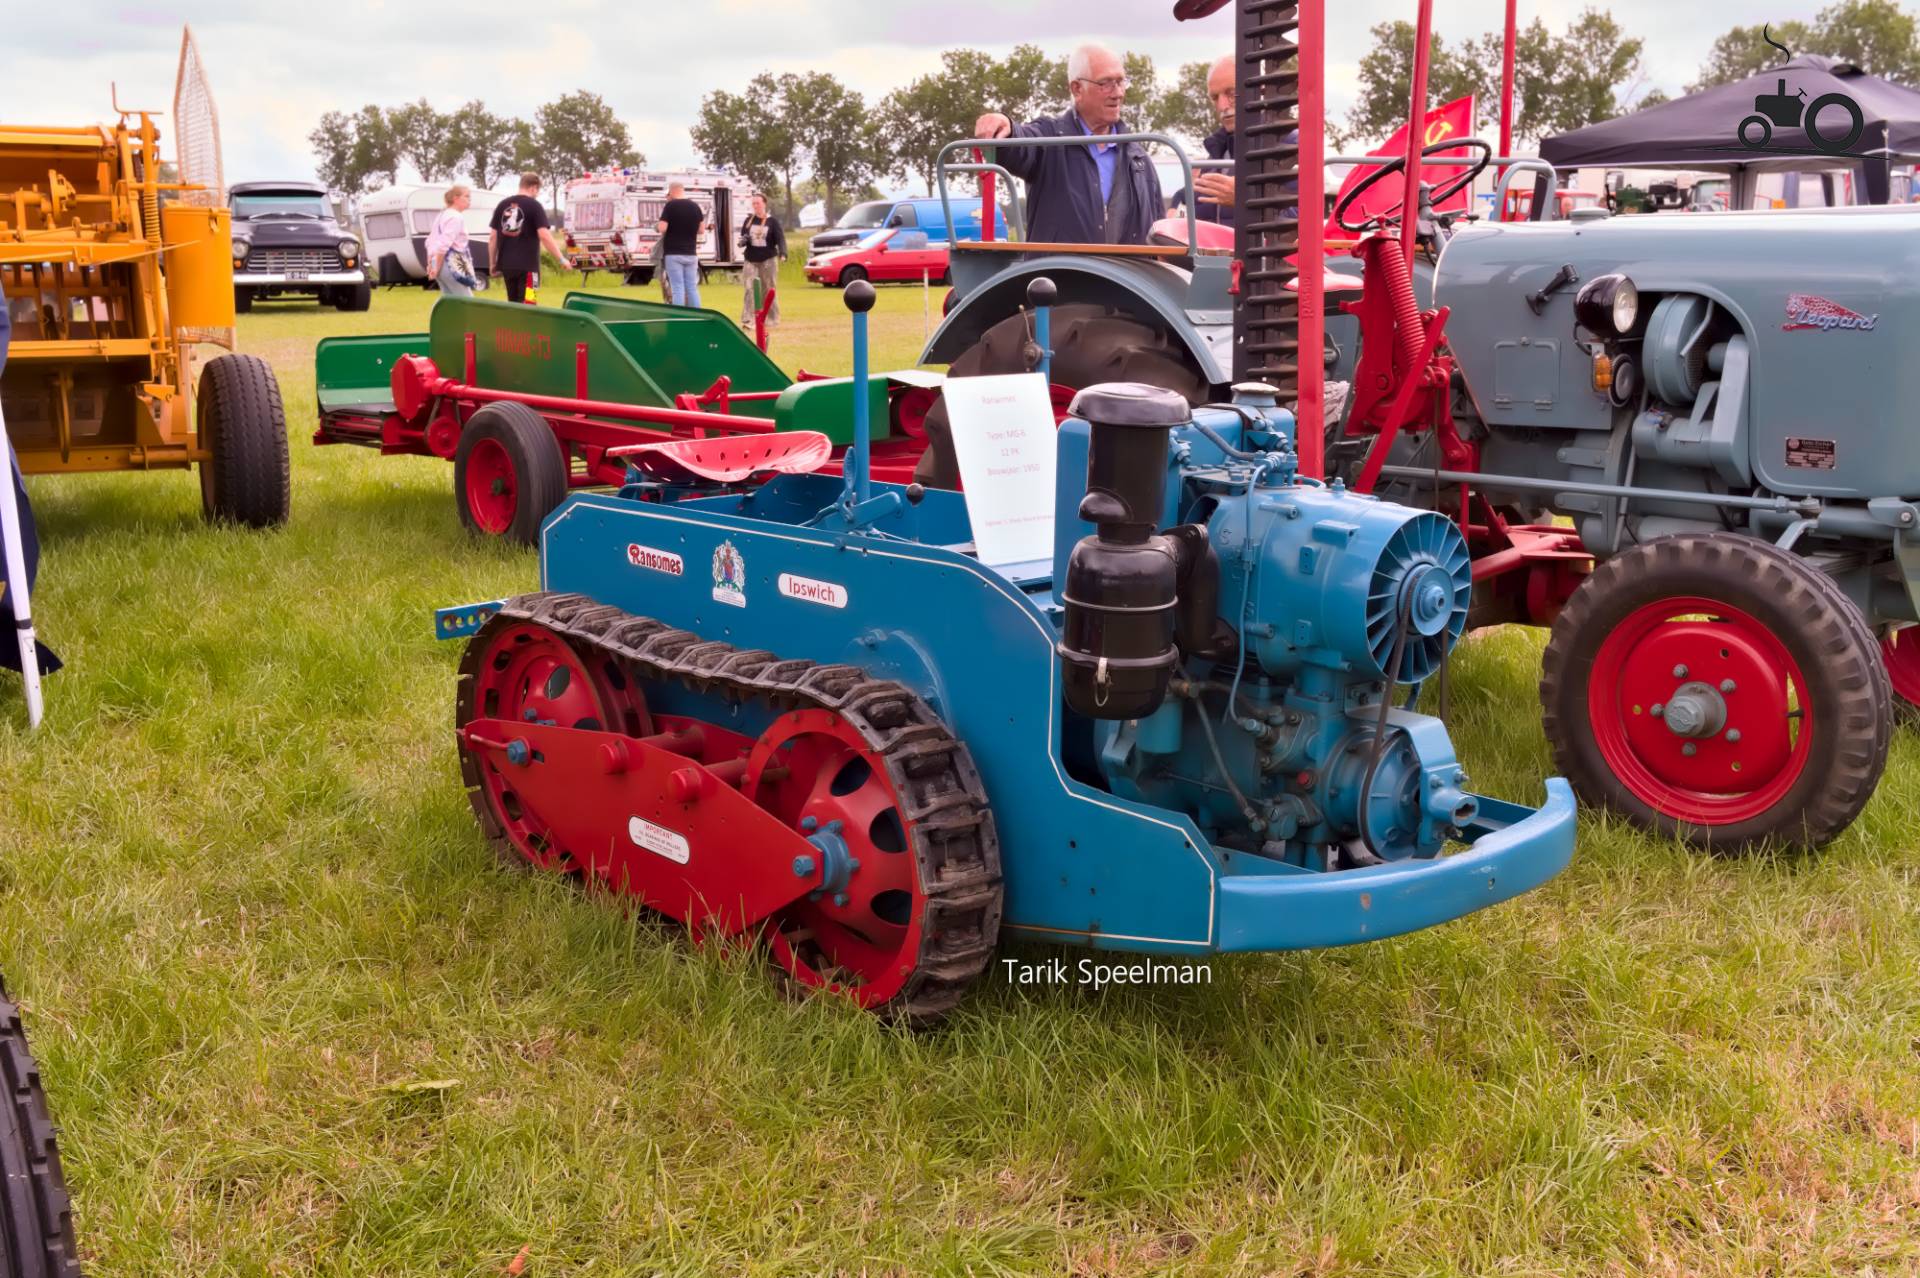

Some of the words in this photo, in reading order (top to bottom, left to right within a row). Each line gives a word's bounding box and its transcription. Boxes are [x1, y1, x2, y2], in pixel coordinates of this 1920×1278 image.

[1797, 308, 1880, 332] Leopard
[628, 544, 682, 575] Ransomes
[788, 576, 836, 603] Ipswich
